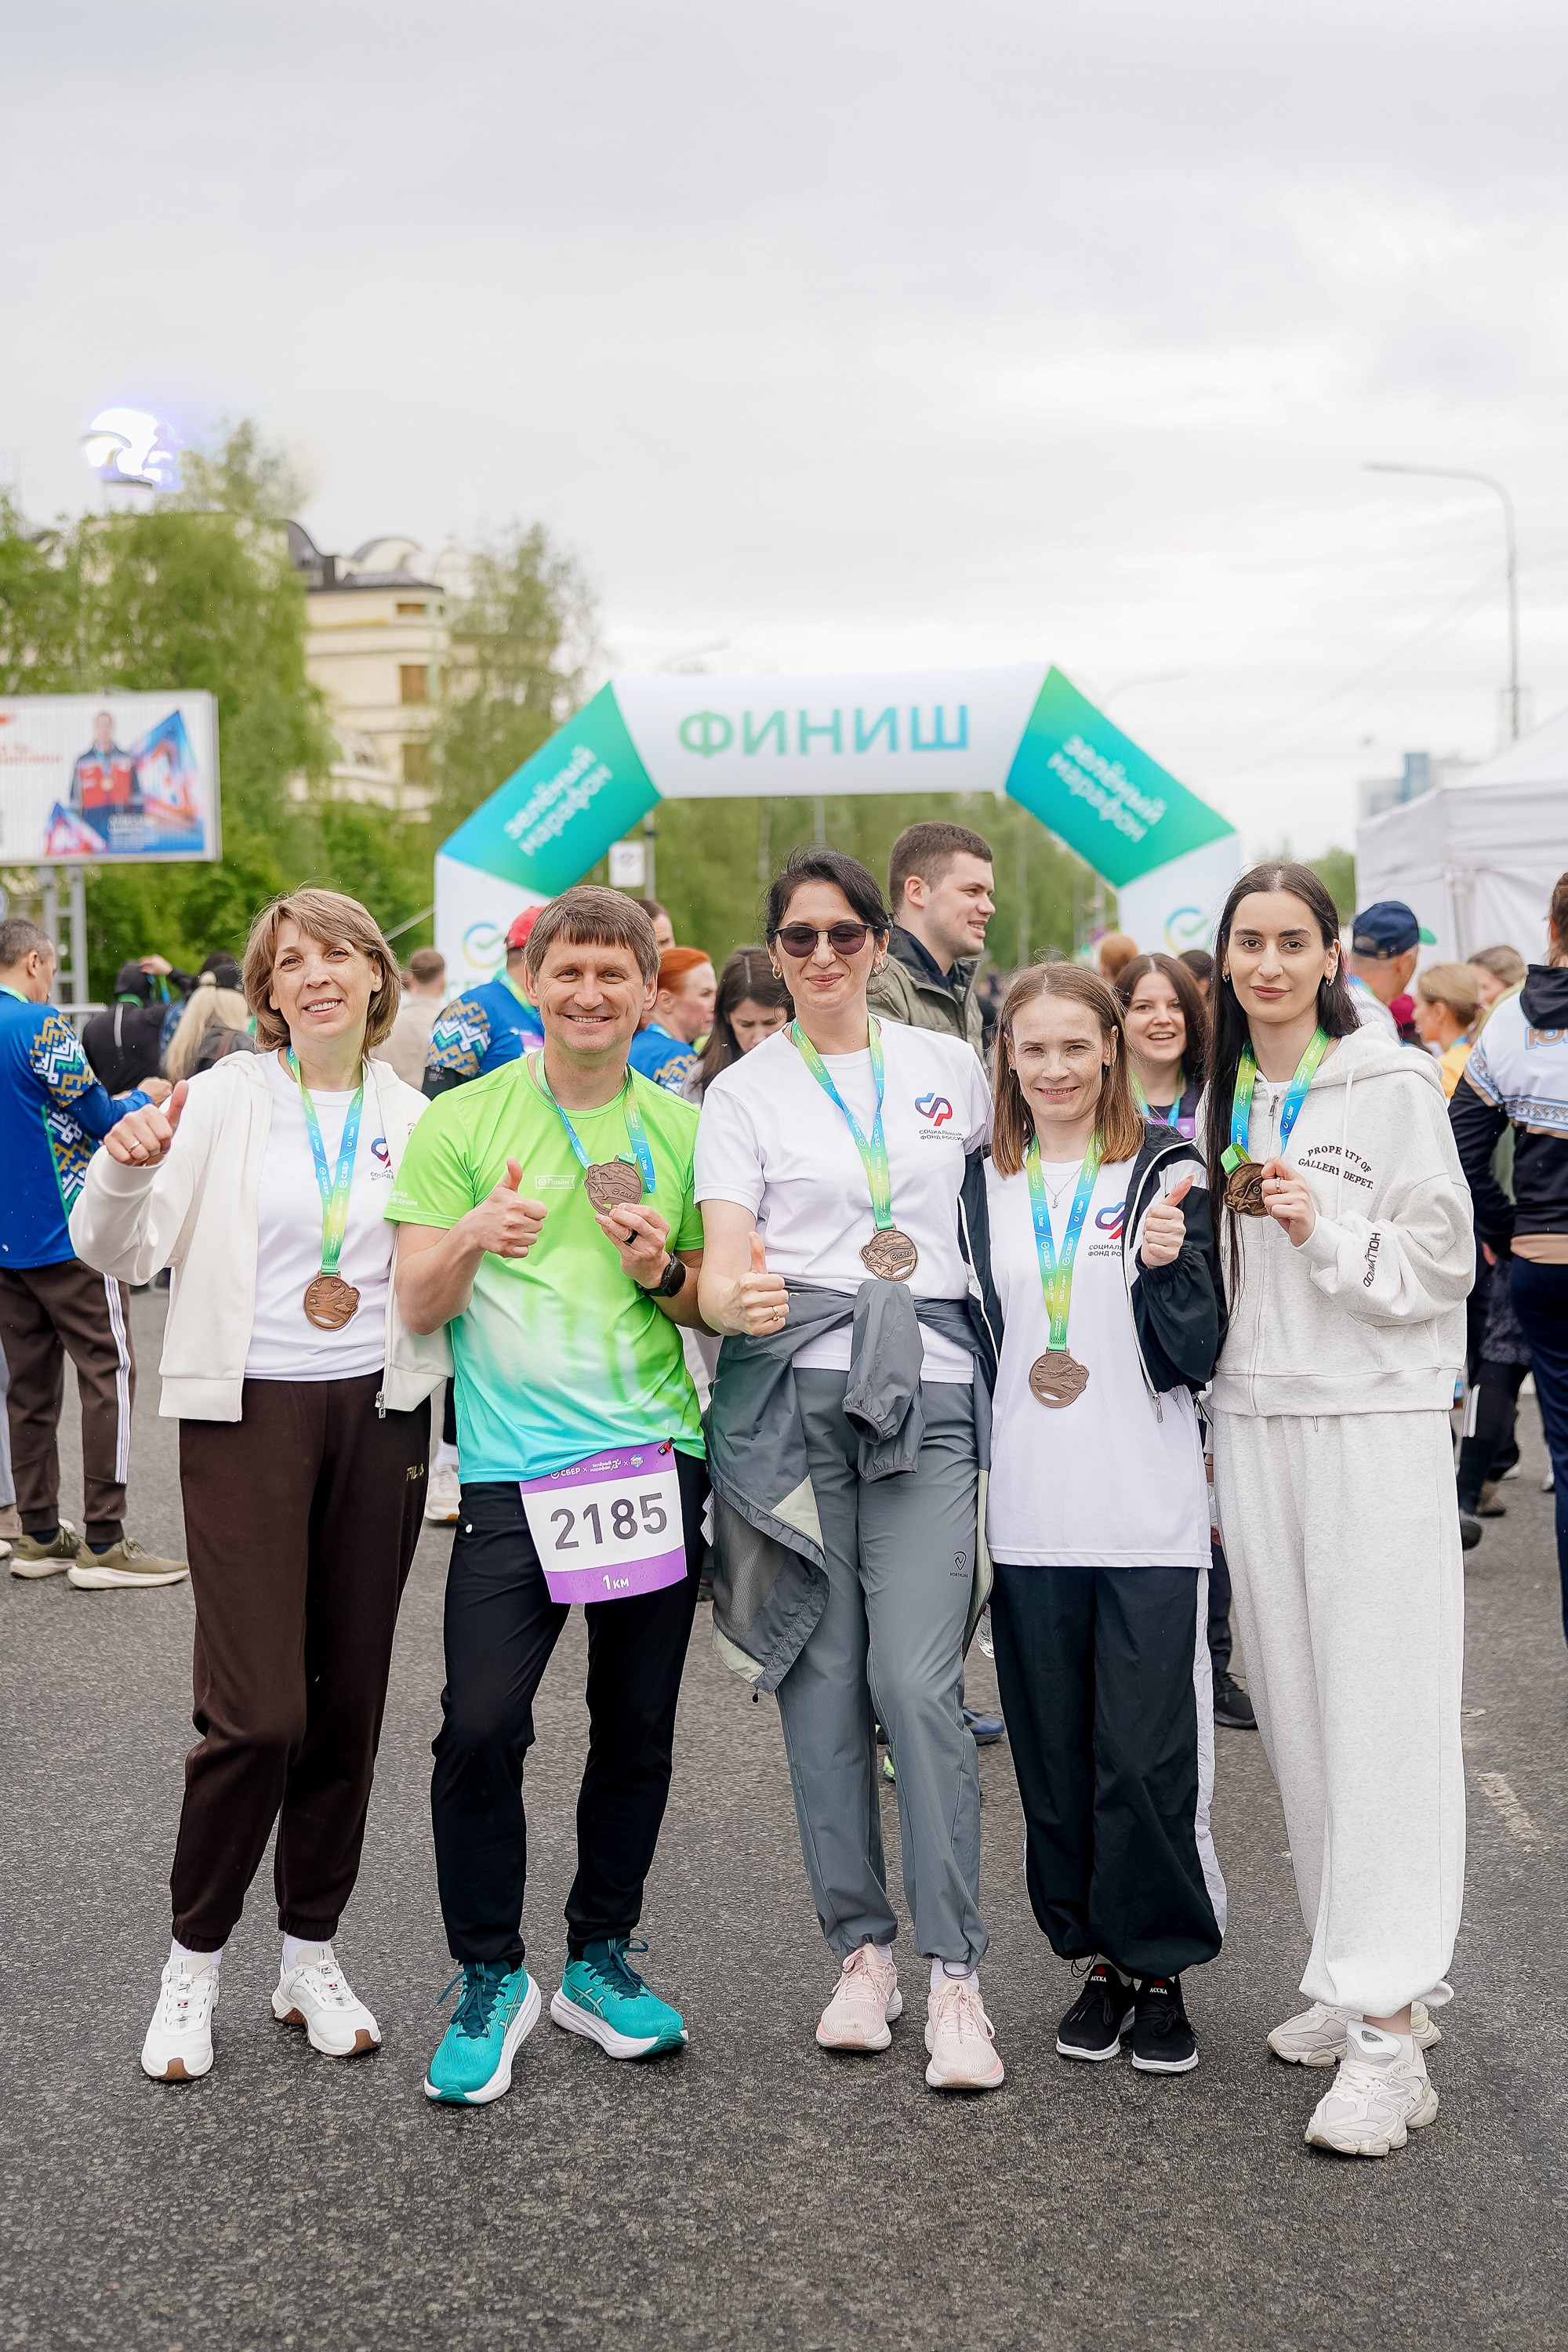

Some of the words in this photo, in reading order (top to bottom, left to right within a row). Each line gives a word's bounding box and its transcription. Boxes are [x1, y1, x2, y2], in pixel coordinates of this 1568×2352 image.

[679, 705, 968, 758] ФИНИШ
[1360, 1161, 1372, 1174] OF
[561, 1467, 581, 1477] СБЕР
[550, 1492, 667, 1550] 2185
